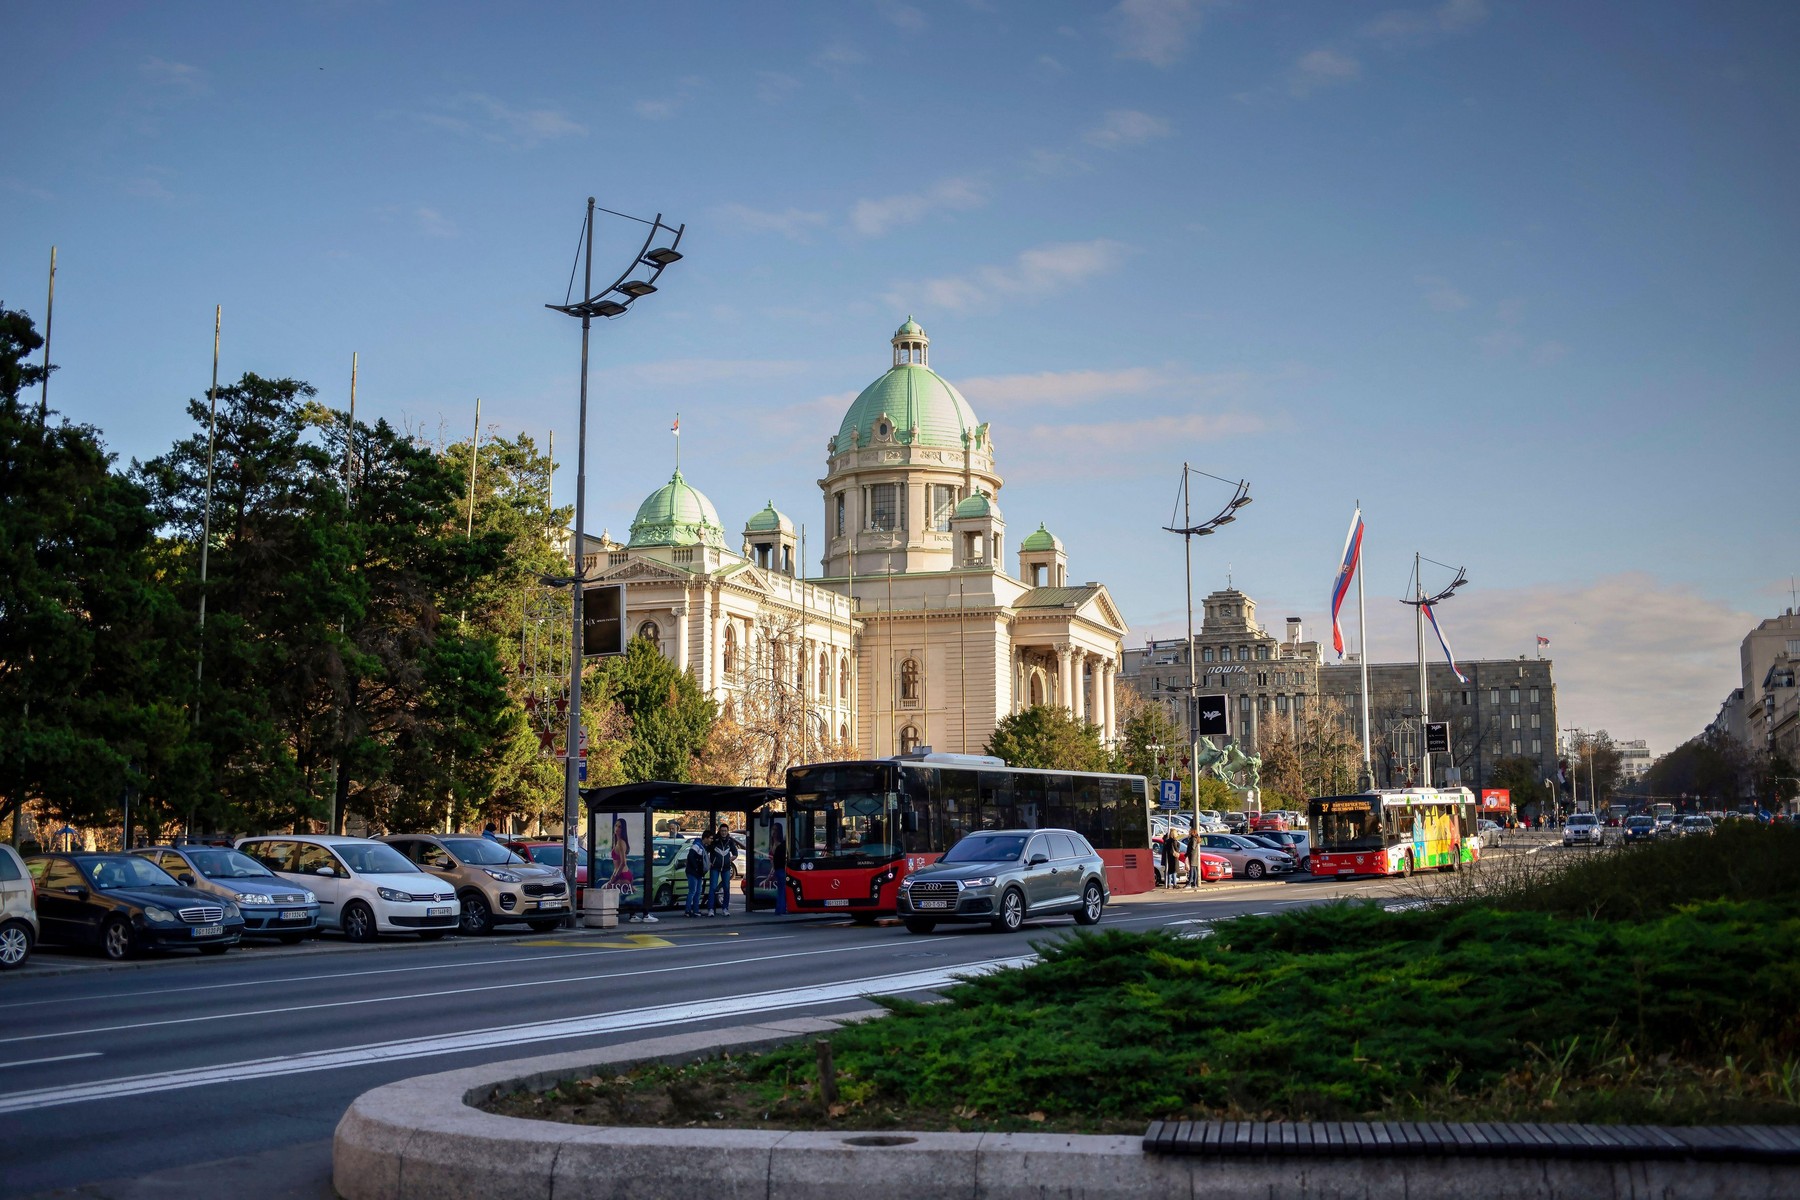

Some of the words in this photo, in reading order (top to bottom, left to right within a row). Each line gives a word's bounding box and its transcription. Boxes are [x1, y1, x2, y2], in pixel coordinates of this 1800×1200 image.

[1206, 666, 1248, 674] ПОШТА
[1321, 803, 1329, 813] 37
[762, 880, 778, 891] LIS
